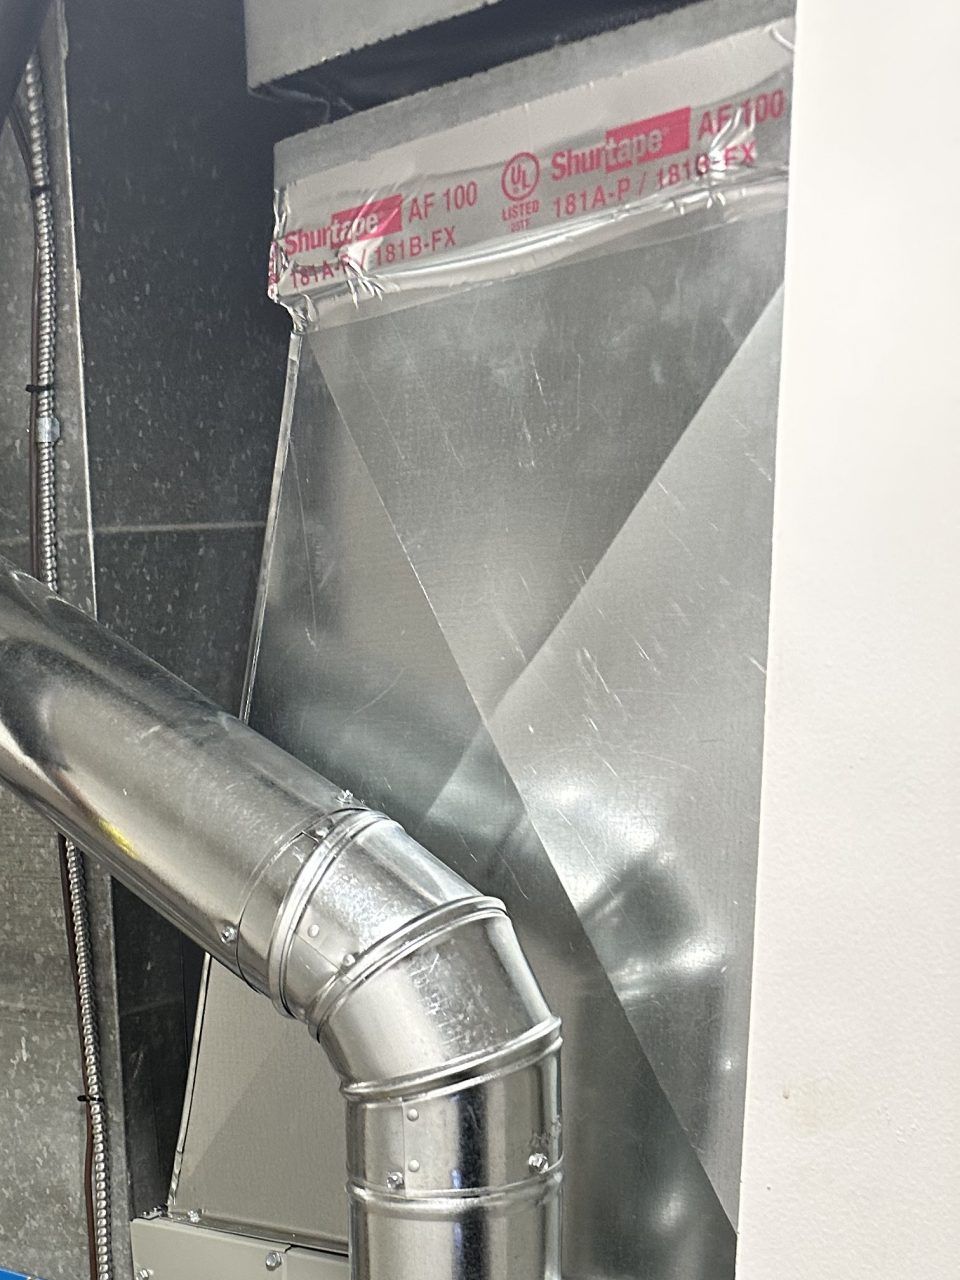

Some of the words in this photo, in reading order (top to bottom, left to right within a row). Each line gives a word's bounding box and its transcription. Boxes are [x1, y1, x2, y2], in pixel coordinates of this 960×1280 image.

[550, 131, 664, 182] Shurtape
[697, 104, 732, 140] AF
[742, 89, 785, 128] 100
[502, 200, 539, 222] LISTED
[554, 179, 630, 218] 181A-P
[284, 213, 379, 256] Shurtape
[408, 193, 435, 223] AF
[444, 181, 478, 211] 100
[375, 226, 456, 265] 181B-FX
